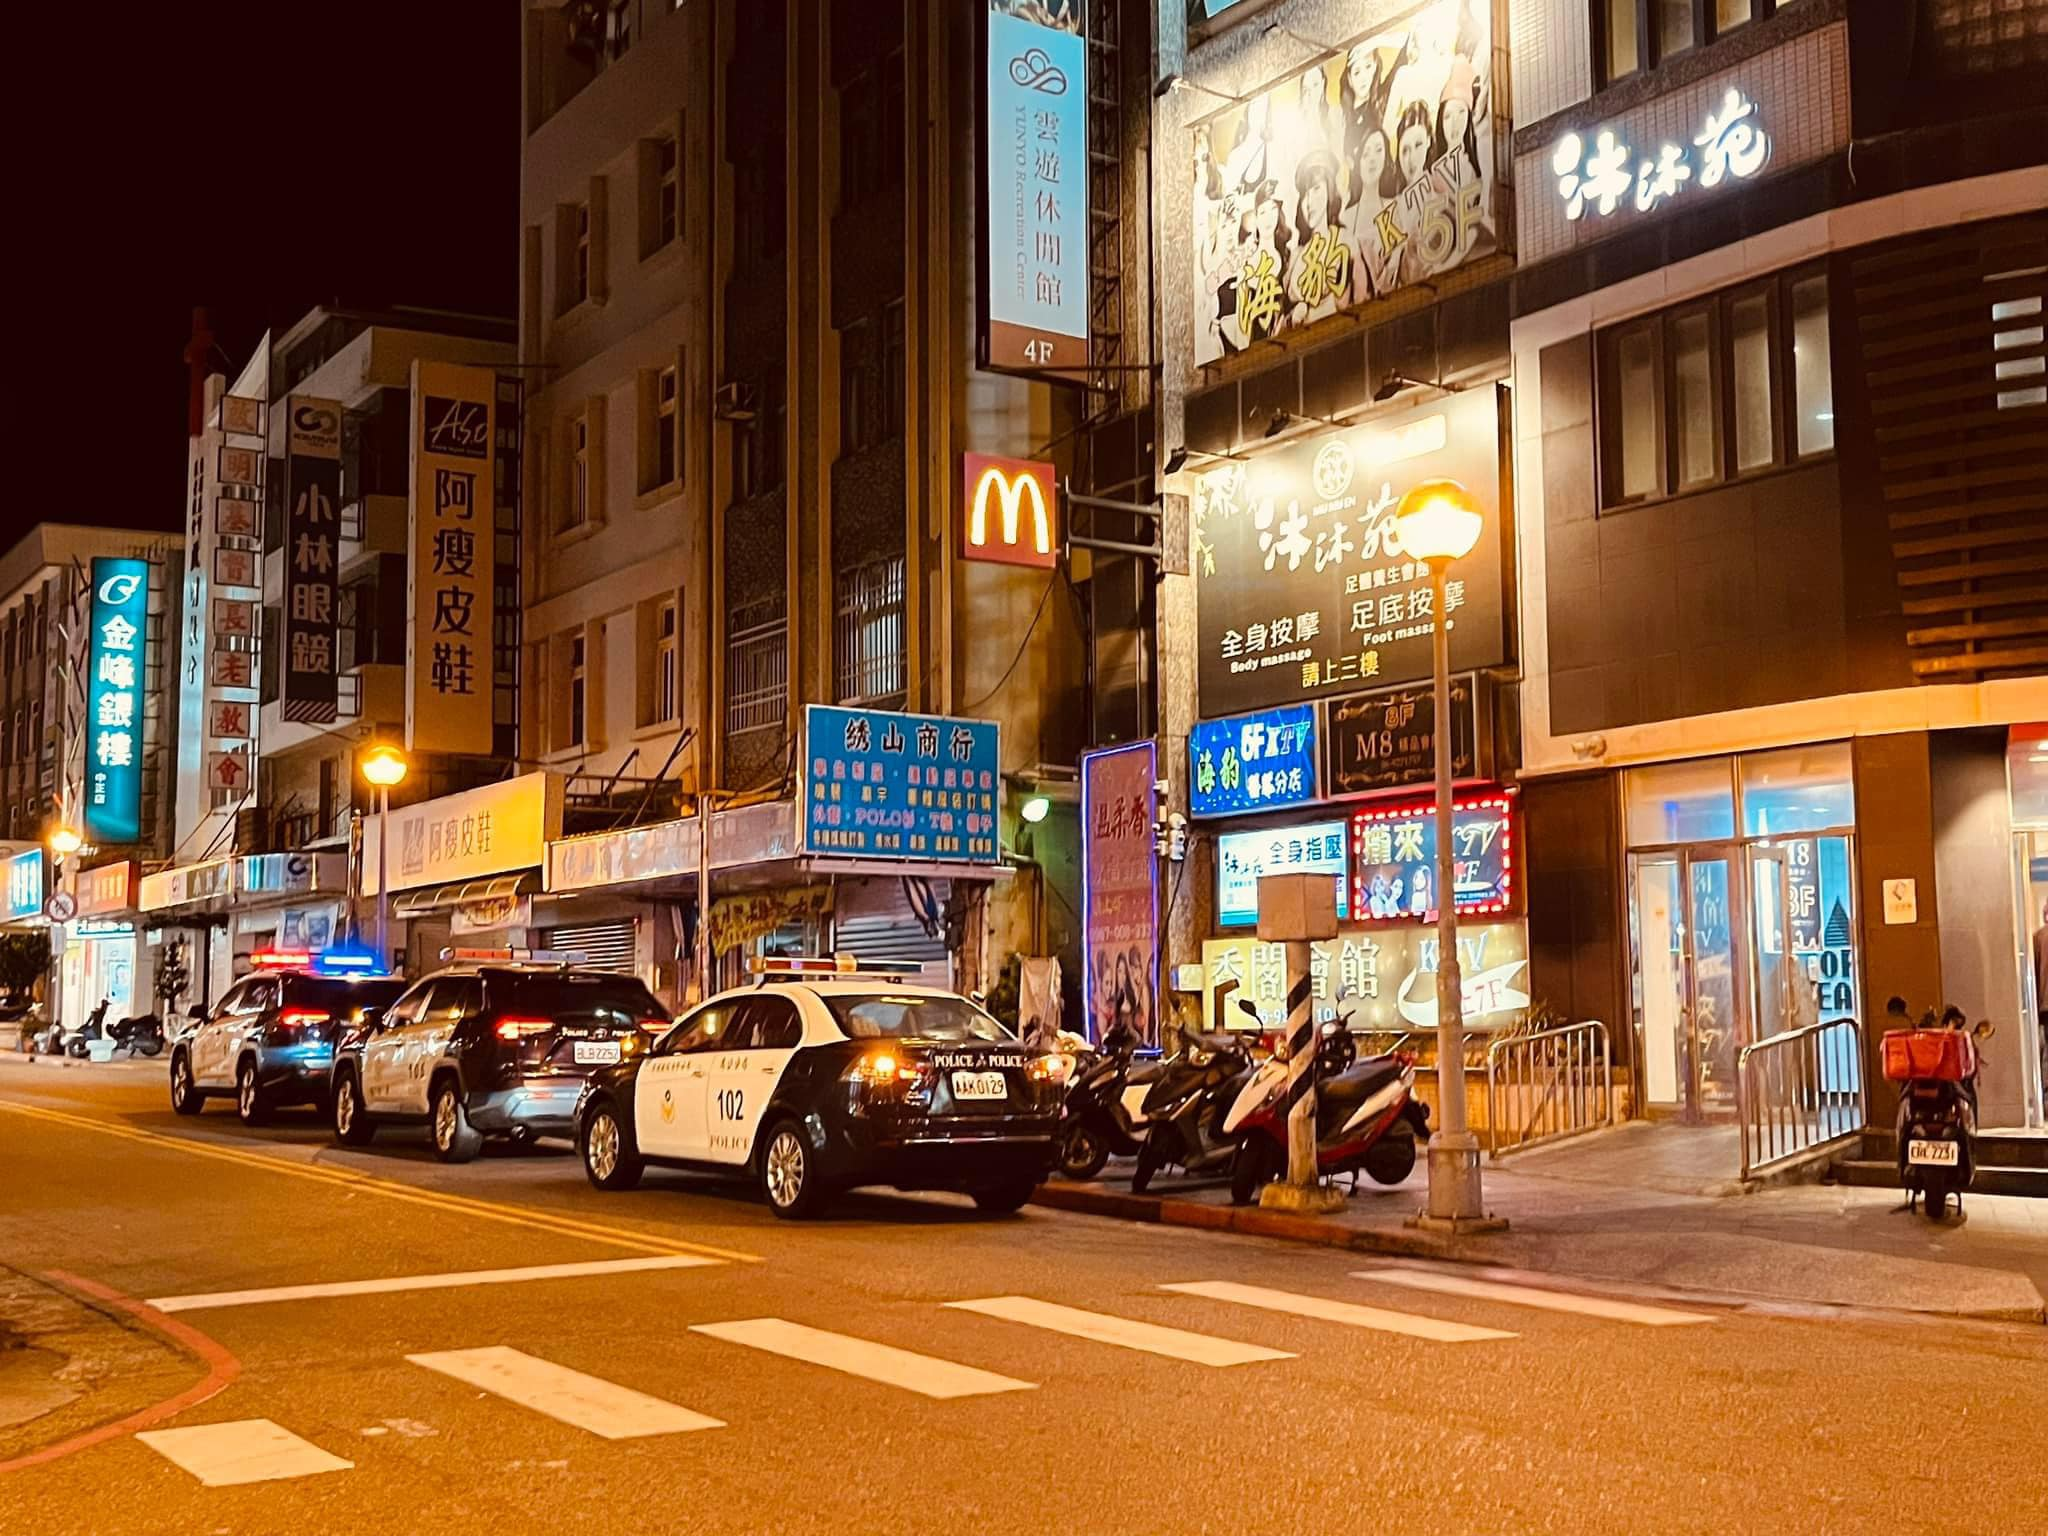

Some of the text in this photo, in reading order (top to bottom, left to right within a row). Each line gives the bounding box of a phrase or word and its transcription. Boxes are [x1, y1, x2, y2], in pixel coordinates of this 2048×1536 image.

[1418, 178, 1484, 268] 5F
[1024, 339, 1054, 364] 4F
[292, 483, 333, 674] 小林眼鏡
[432, 468, 477, 695] 阿瘦皮鞋
[1221, 611, 1320, 659] 全身按摩
[1363, 620, 1454, 647] Foot massae
[1230, 648, 1313, 675] Body massage
[1302, 650, 1380, 688] 請上三樓
[1356, 730, 1393, 763] M8
[428, 810, 491, 864] 阿瘦皮鞋
[1270, 834, 1342, 865] 全身指壓
[935, 1055, 1023, 1067] POLICE POLICE
[717, 1089, 744, 1120] 102
[710, 1135, 749, 1150] POLICE
